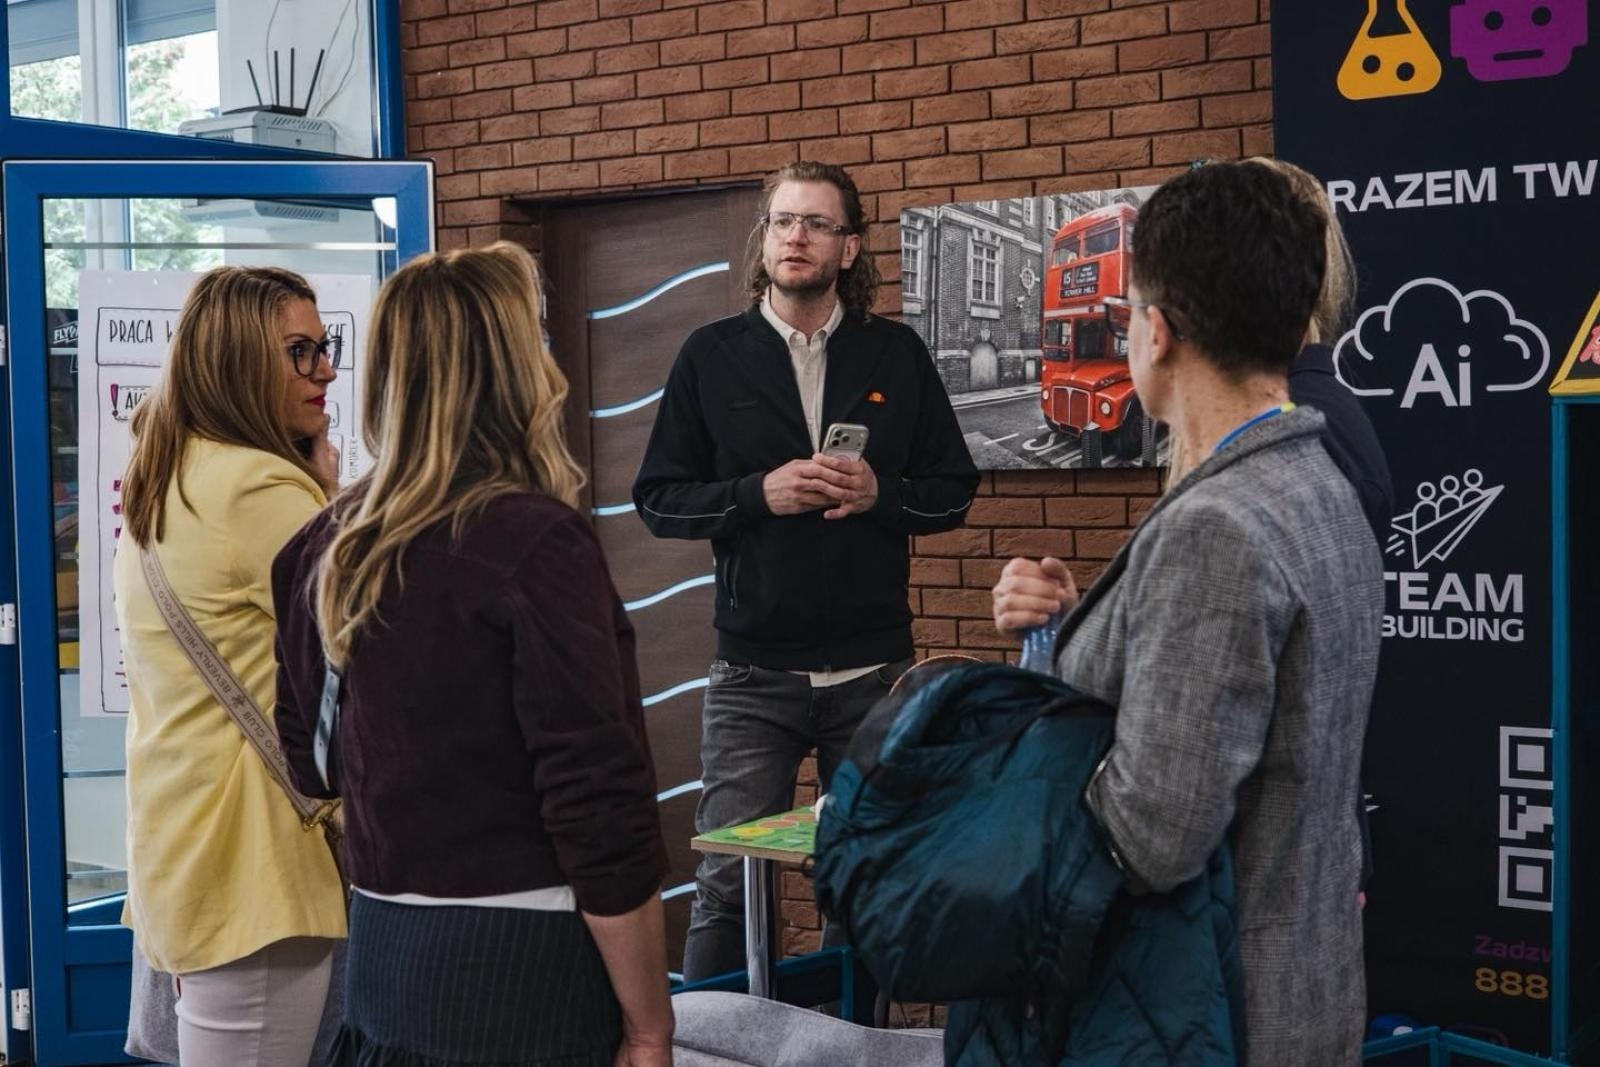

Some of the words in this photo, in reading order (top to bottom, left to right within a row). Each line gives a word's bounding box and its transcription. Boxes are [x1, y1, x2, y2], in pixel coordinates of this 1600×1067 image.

[1327, 166, 1497, 213] RAZEM
[109, 319, 153, 344] PRACA
[1400, 343, 1471, 408] Ai
[158, 590, 177, 619] POLO
[175, 620, 198, 649] HILLS
[1382, 615, 1525, 642] BUILDING
[196, 650, 232, 694] BEVERLY
[242, 711, 266, 739] CLUB
[1475, 967, 1549, 999] 888
